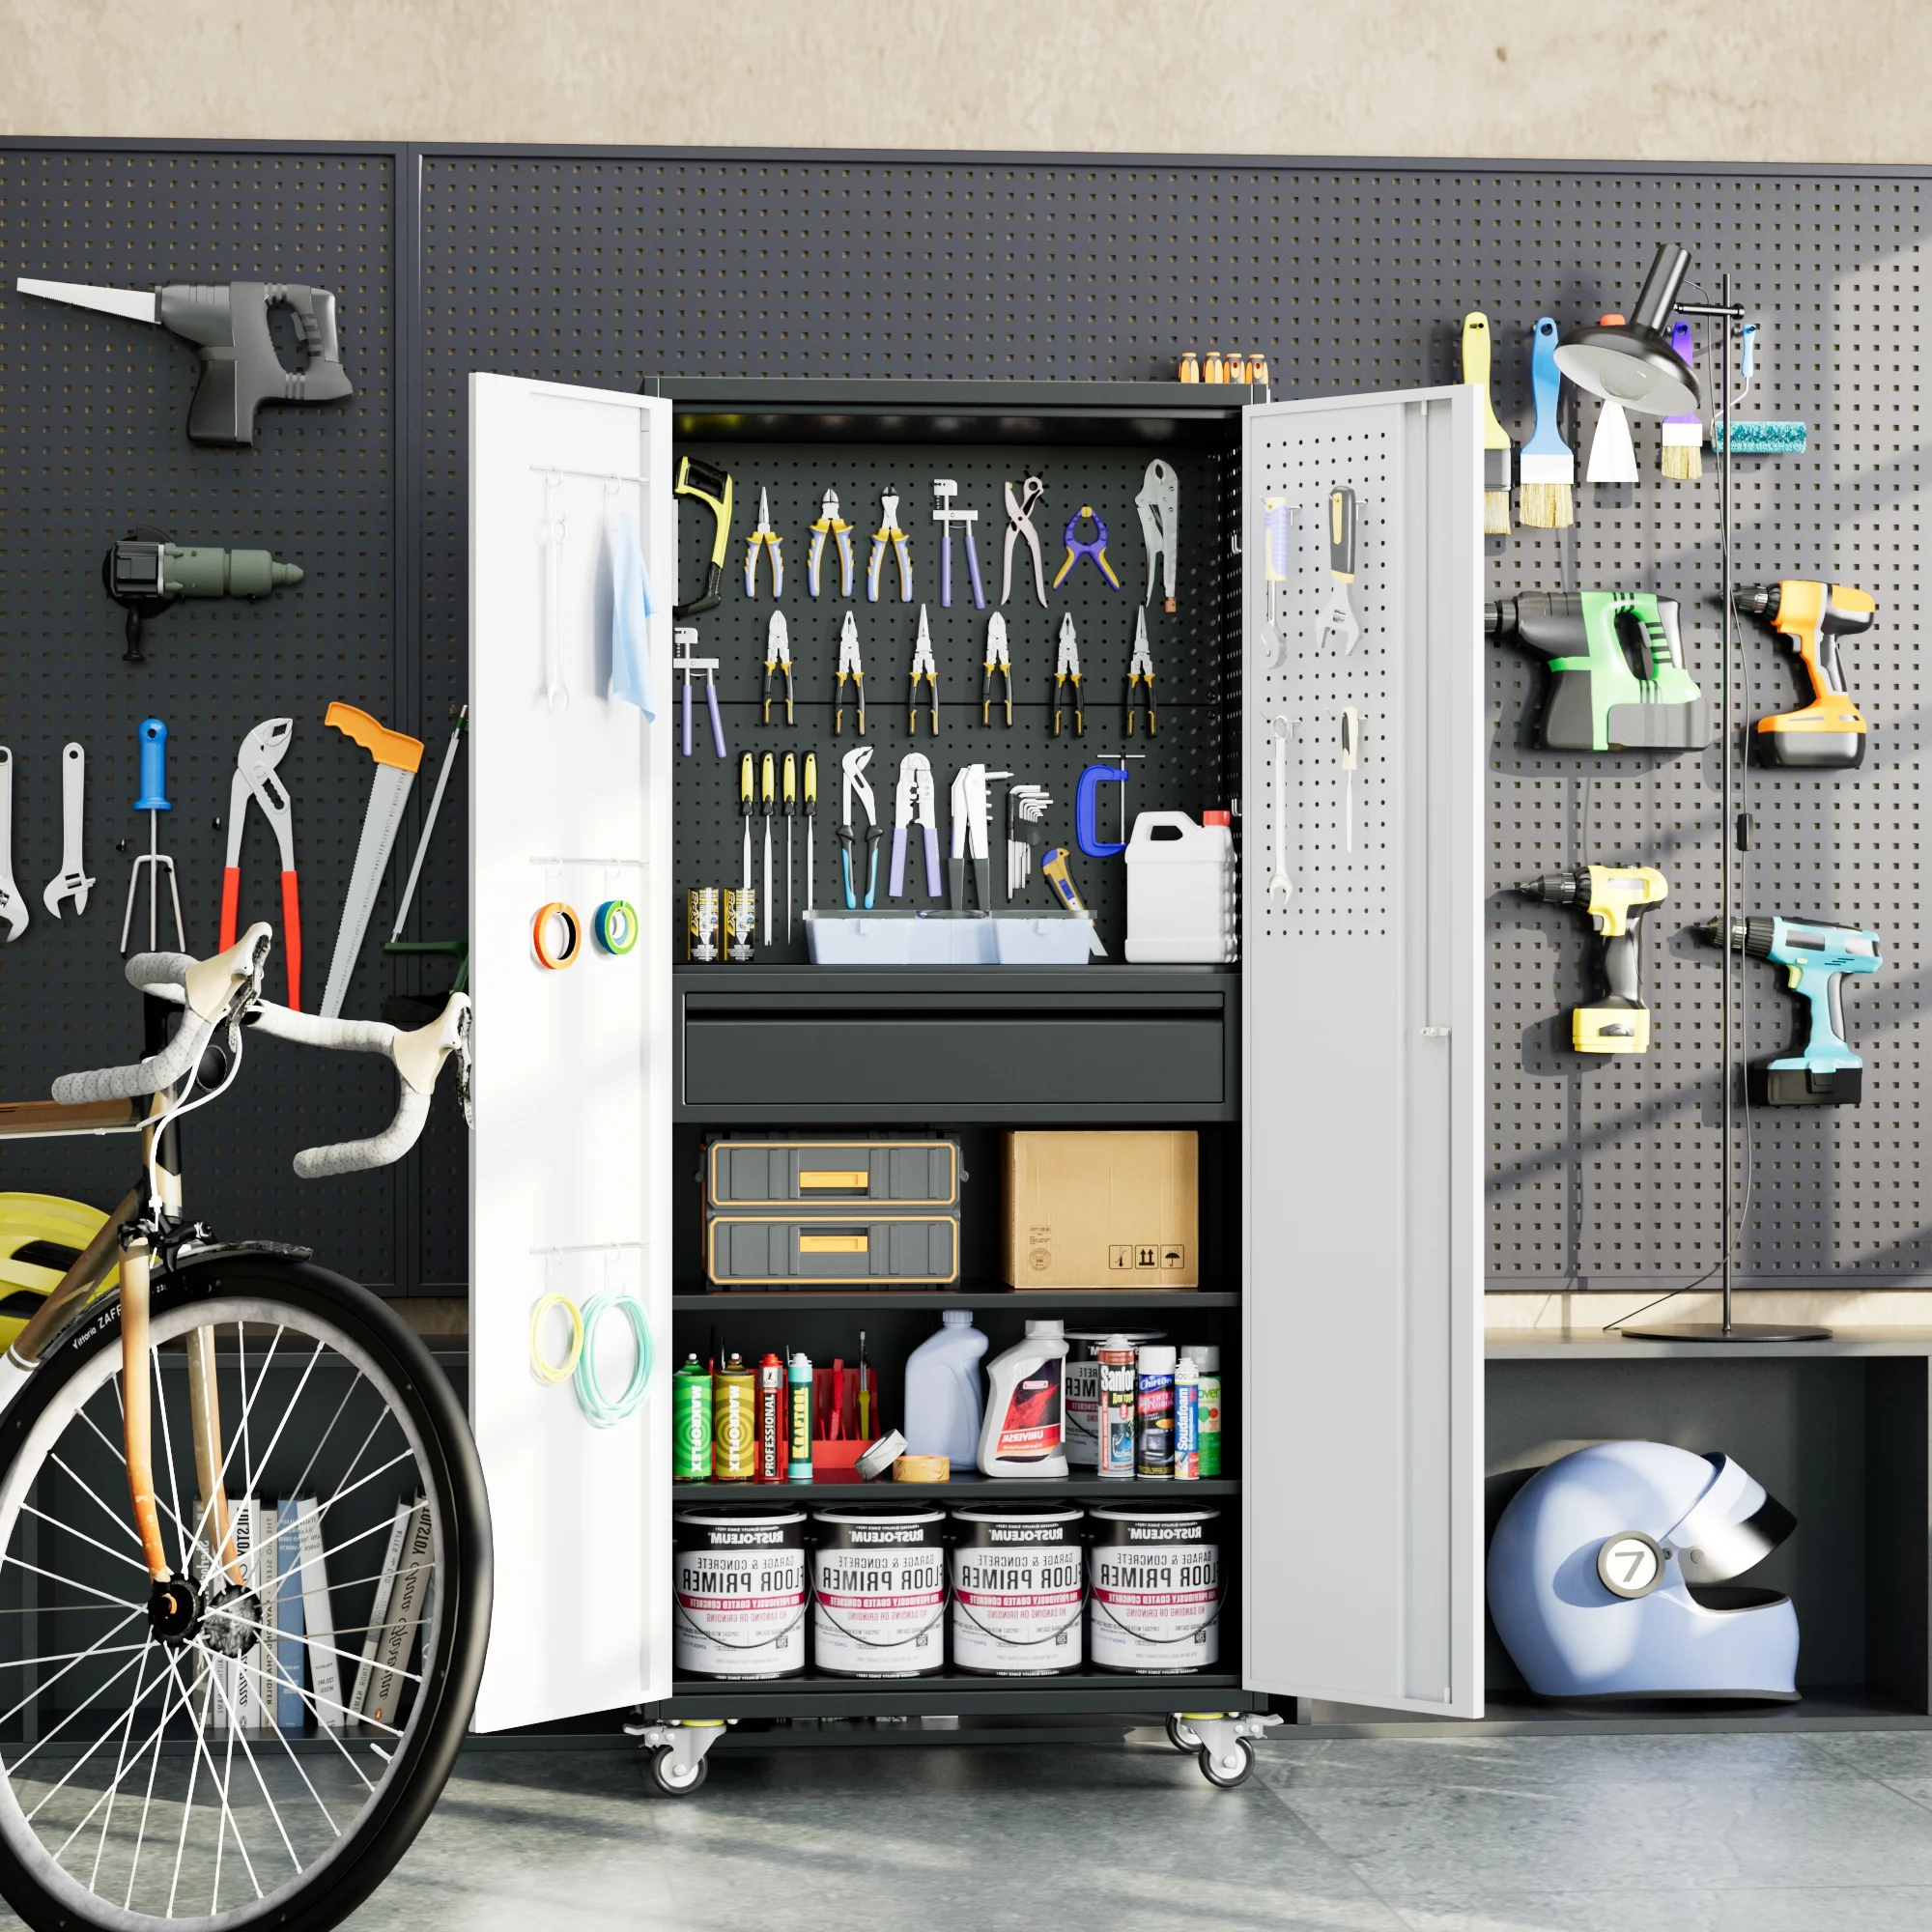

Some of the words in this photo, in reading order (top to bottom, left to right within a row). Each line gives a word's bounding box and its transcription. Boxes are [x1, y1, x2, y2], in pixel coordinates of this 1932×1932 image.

[72, 1326, 97, 1350] Vittoria
[1101, 1365, 1134, 1391] Sanfor
[1140, 1378, 1172, 1390] Chirton
[1198, 1388, 1219, 1399] over
[692, 1385, 701, 1472] MAKROFLEX
[728, 1385, 740, 1472] MAKROFLEX
[765, 1394, 775, 1476] PROFESSIONAL
[792, 1387, 806, 1459] KRAFTOOL
[1177, 1388, 1188, 1451] Soudafoam
[1614, 1551, 1644, 1583] 7
